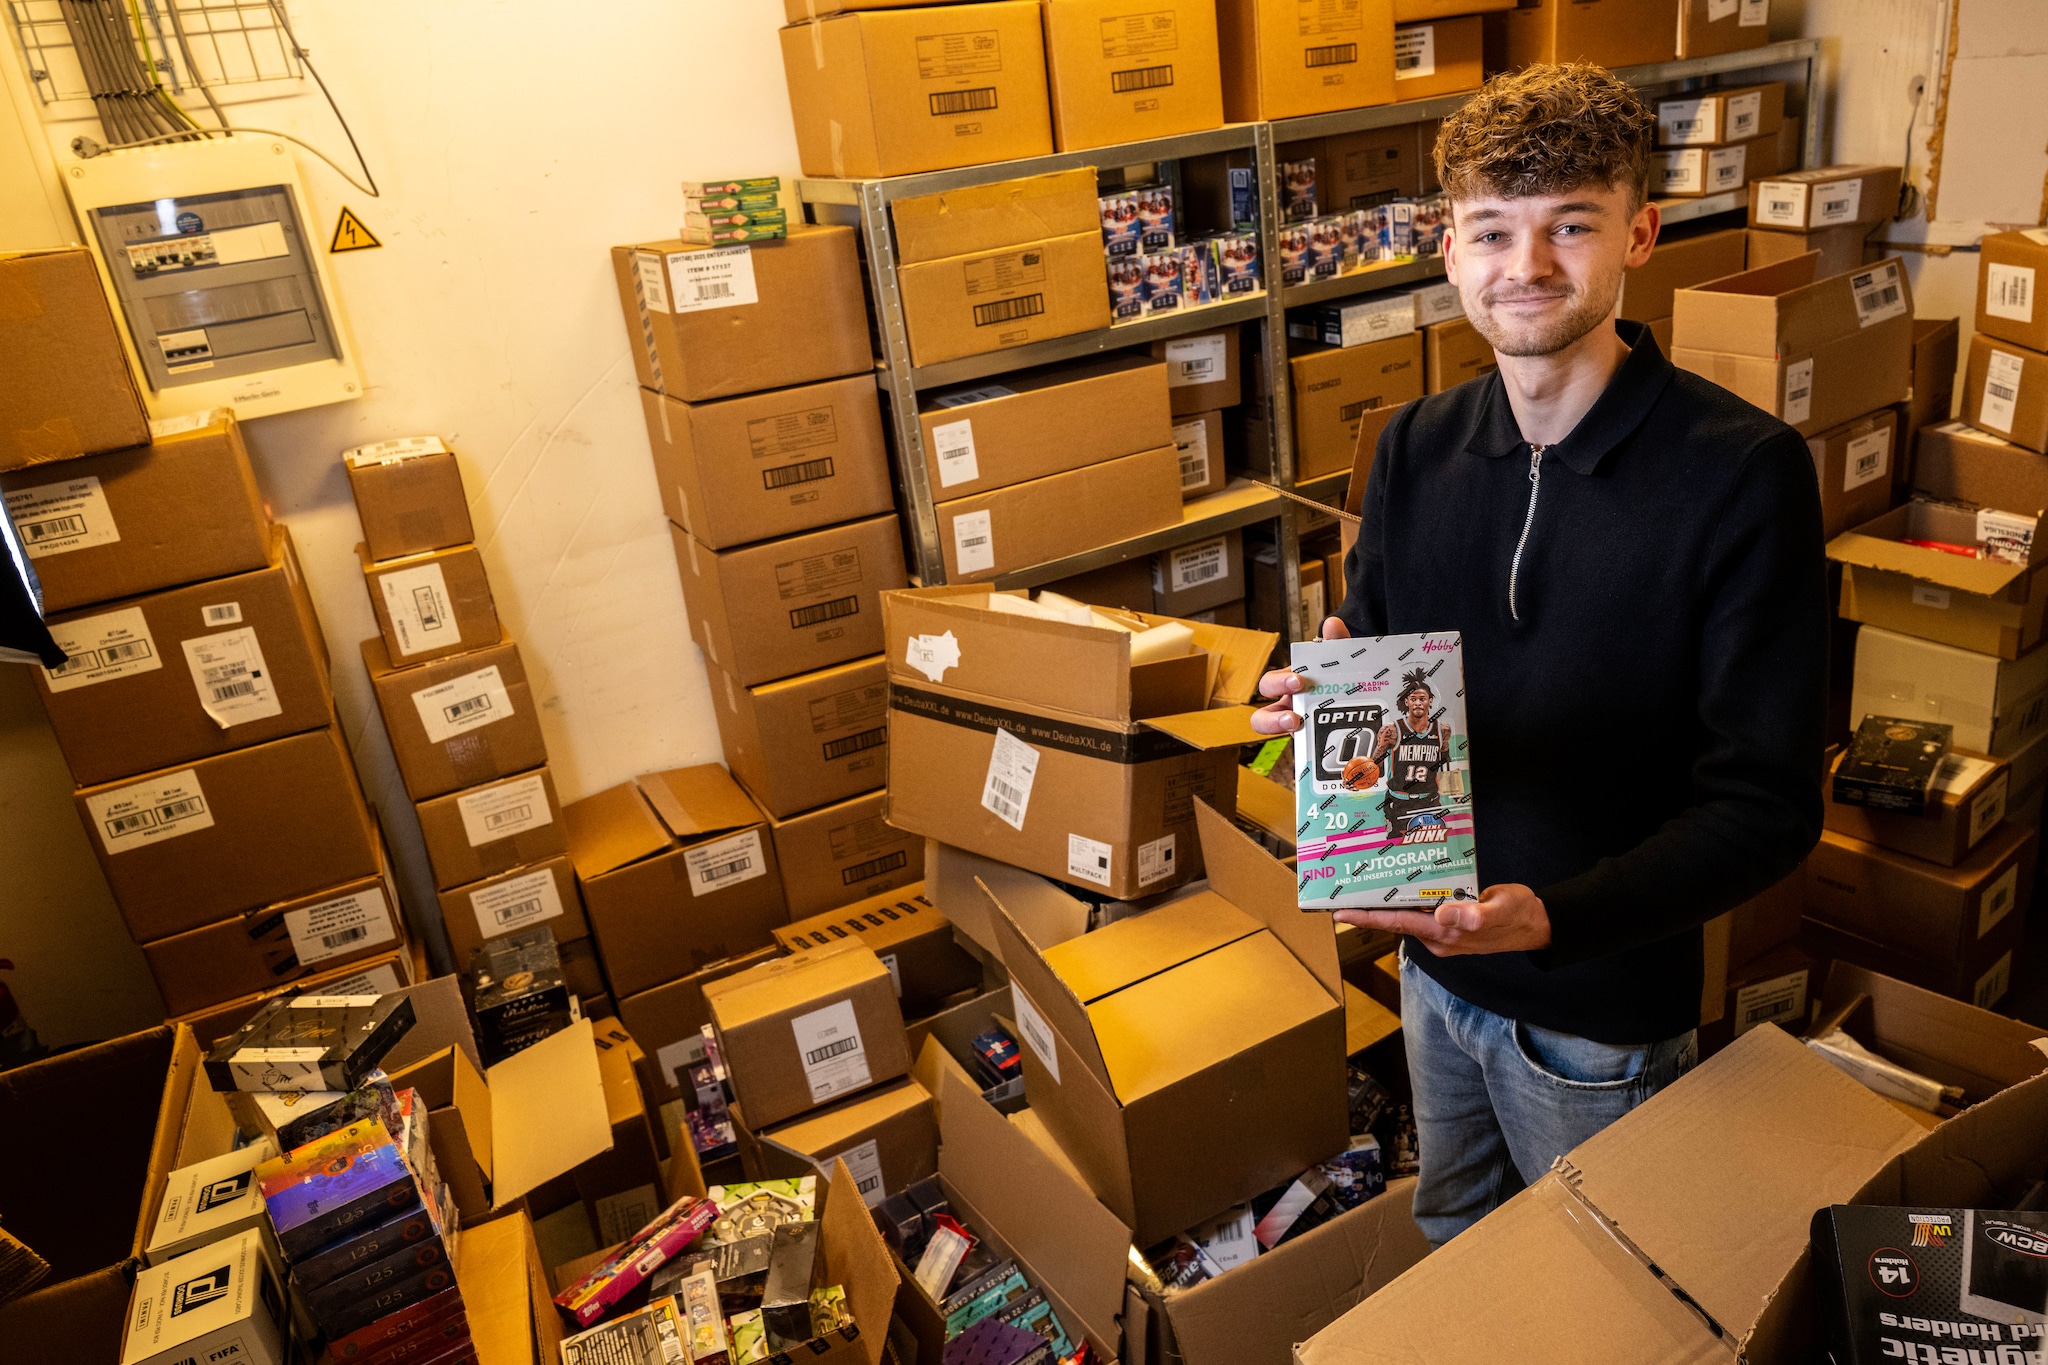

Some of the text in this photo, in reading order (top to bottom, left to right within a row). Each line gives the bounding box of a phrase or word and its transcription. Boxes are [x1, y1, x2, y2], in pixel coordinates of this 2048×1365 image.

[707, 248, 749, 260] ENTERTAINMENT
[711, 263, 731, 271] 17137
[1422, 639, 1455, 654] Hobby
[1317, 709, 1380, 724] OPTIC
[954, 709, 1026, 734] www.DeubaXXL.de
[1031, 727, 1112, 753] www.DeubaXXL.de
[1399, 744, 1440, 762] MEMPHIS
[1404, 765, 1428, 783] 12
[1306, 802, 1320, 820] 4
[1324, 812, 1349, 831] 20
[1402, 828, 1448, 844] DUNK
[1070, 864, 1103, 880] MULTIPACK
[1302, 846, 1448, 881] FIND 1 AUTOGRAPH
[1140, 868, 1170, 883] MULTIPACK
[1353, 875, 1361, 883] 20
[1363, 871, 1393, 881] INSERTS
[1408, 864, 1432, 874] PRIZM
[358, 1143, 379, 1162] 125
[166, 1198, 178, 1220] PANINI
[1909, 1215, 1951, 1224] PROTECTION
[1933, 1225, 1952, 1236] UV
[351, 1239, 379, 1260] 125
[1997, 1230, 2048, 1254] BCW
[1874, 1257, 1909, 1266] Holders
[366, 1265, 393, 1287] 125
[1878, 1266, 1911, 1284] 14
[173, 1283, 185, 1315] DONRUSS
[374, 1290, 402, 1310] 125
[967, 1284, 985, 1299] NA
[138, 1300, 148, 1327] PANINI
[941, 1295, 968, 1315] CARDS
[1880, 1312, 2002, 1342] Holders
[209, 1343, 239, 1362] FIFA
